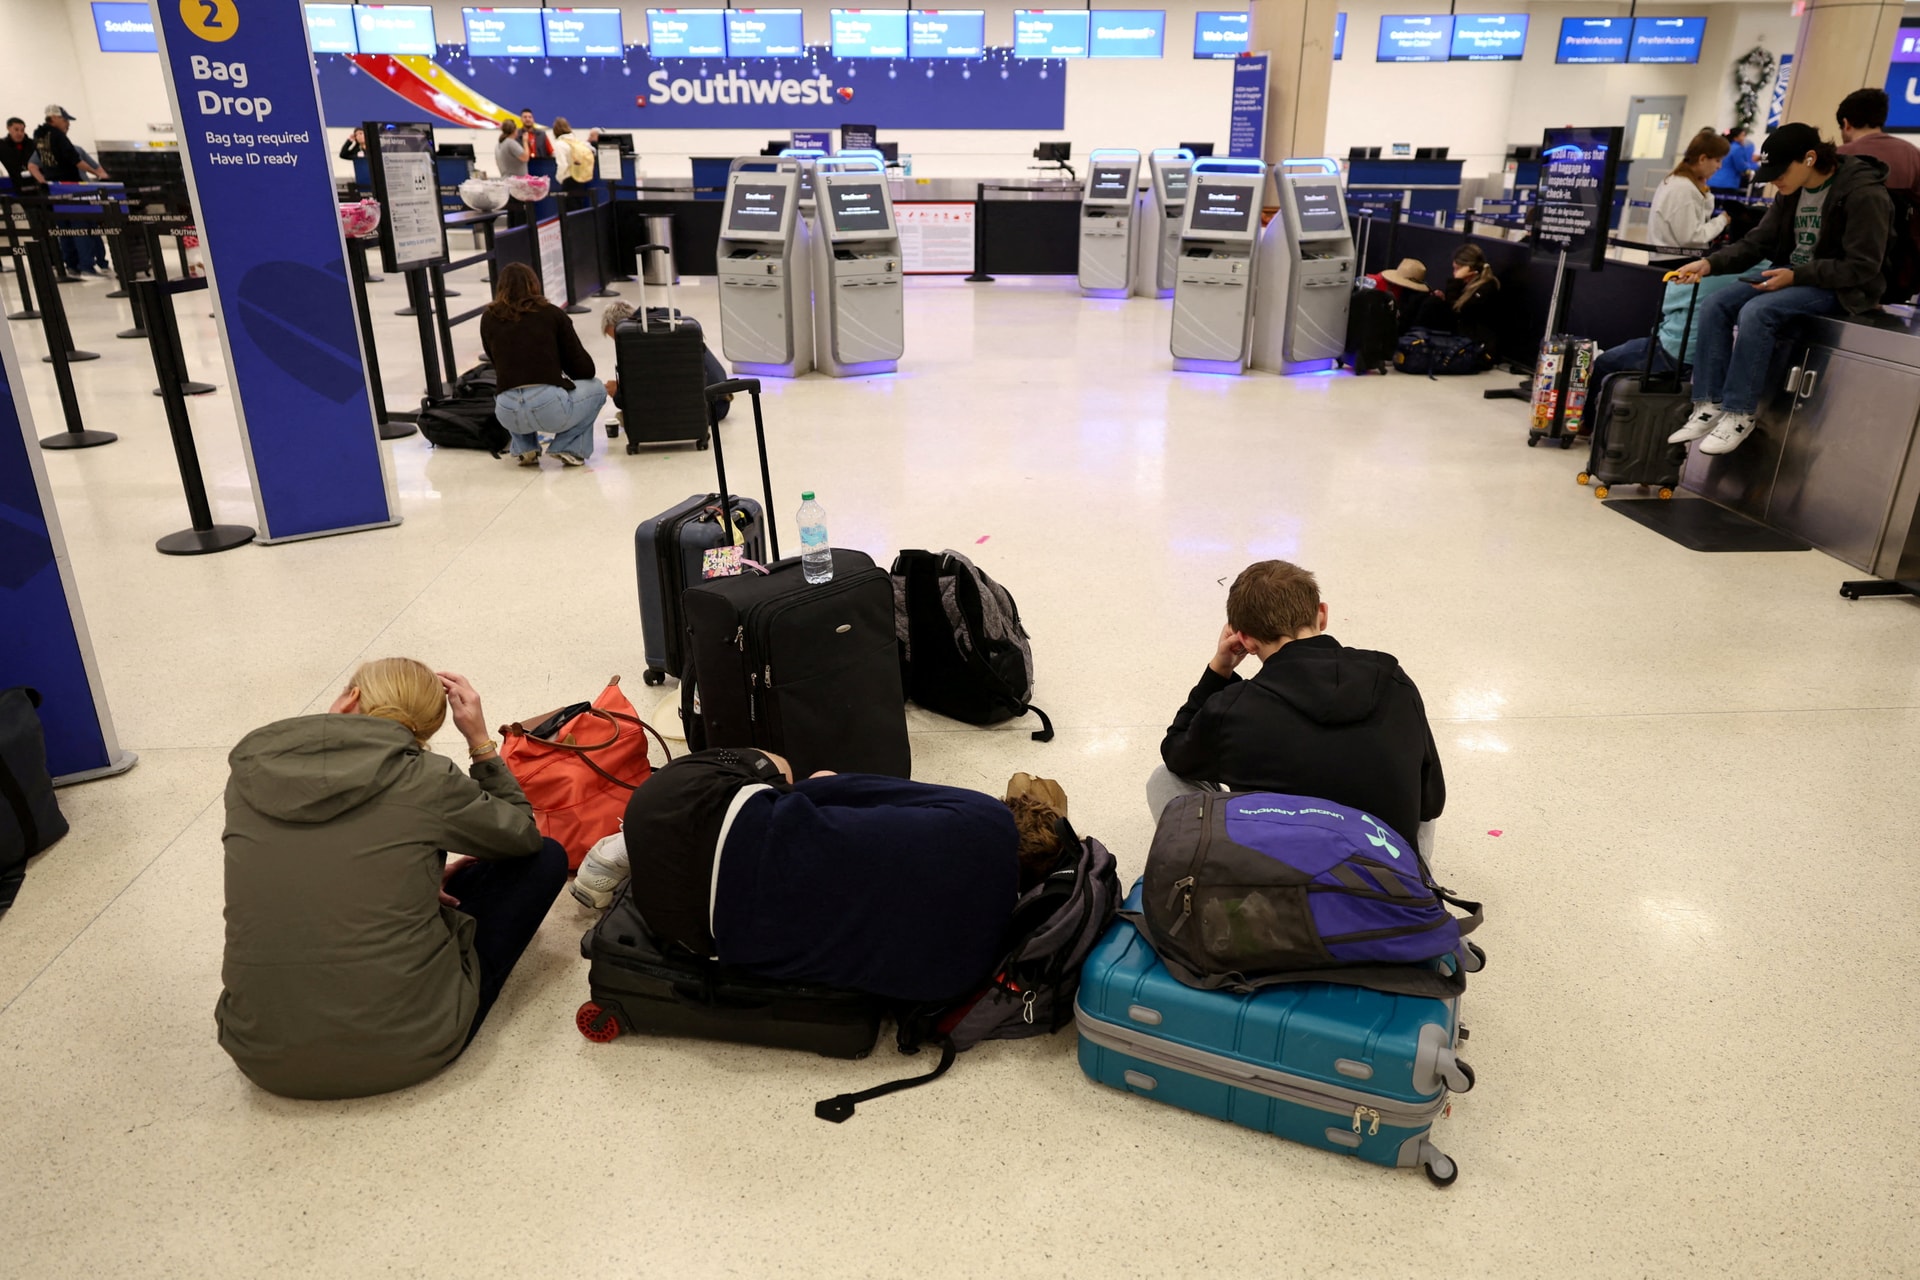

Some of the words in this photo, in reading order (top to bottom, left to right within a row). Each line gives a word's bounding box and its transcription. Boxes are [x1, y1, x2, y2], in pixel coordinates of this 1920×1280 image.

[199, 0, 223, 28] 2
[104, 20, 155, 32] Southwes
[190, 55, 248, 88] Bag
[648, 69, 833, 105] Southwest
[197, 90, 272, 122] Drop
[205, 131, 231, 147] Bag
[233, 132, 255, 147] tag
[257, 130, 310, 147] required
[795, 140, 807, 148] Bag
[209, 152, 244, 165] Have
[246, 152, 261, 165] ID
[264, 152, 298, 167] ready
[1592, 150, 1605, 160] that
[1550, 162, 1558, 173] all
[1558, 163, 1582, 175] baggage
[1582, 163, 1591, 174] be
[732, 175, 739, 184] 7
[826, 176, 832, 185] 5
[1197, 175, 1204, 184] 6
[1548, 177, 1575, 187] inspected
[1575, 176, 1590, 188] prior
[1591, 178, 1598, 188] to
[1546, 189, 1572, 200] check-in.
[128, 214, 161, 222] SOUTHWEST
[47, 228, 89, 237] SOUTHWEST
[91, 228, 120, 236] AIRLINES
[170, 228, 197, 236] SOUTHW
[1239, 808, 1296, 816] ARMOUR
[1300, 808, 1344, 821] UNDER
